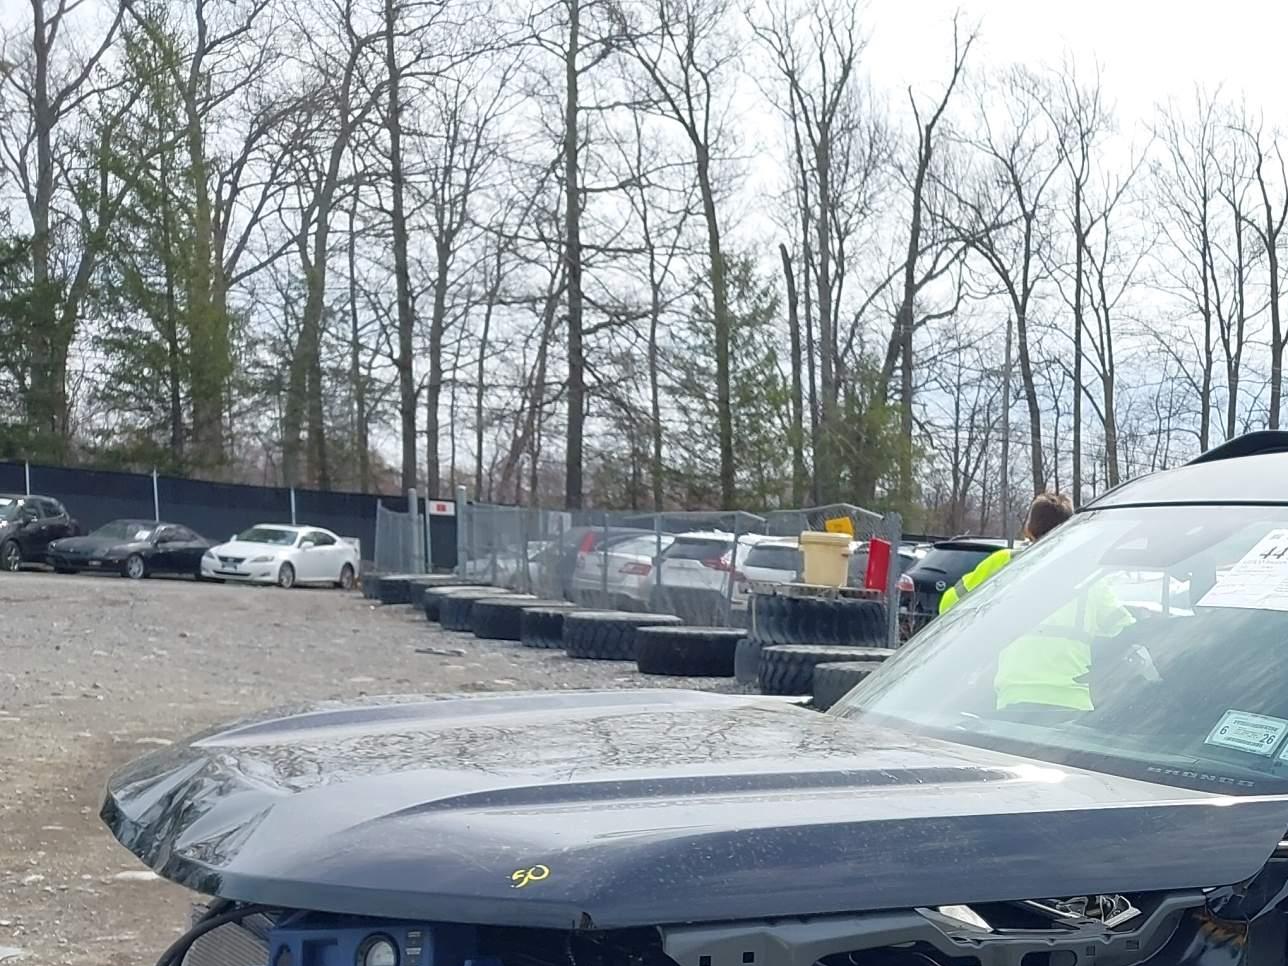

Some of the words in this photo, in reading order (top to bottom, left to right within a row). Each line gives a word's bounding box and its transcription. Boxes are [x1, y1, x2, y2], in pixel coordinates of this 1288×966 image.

[1219, 725, 1230, 735] 6
[1259, 733, 1276, 745] 26
[1147, 766, 1256, 788] BRONCO
